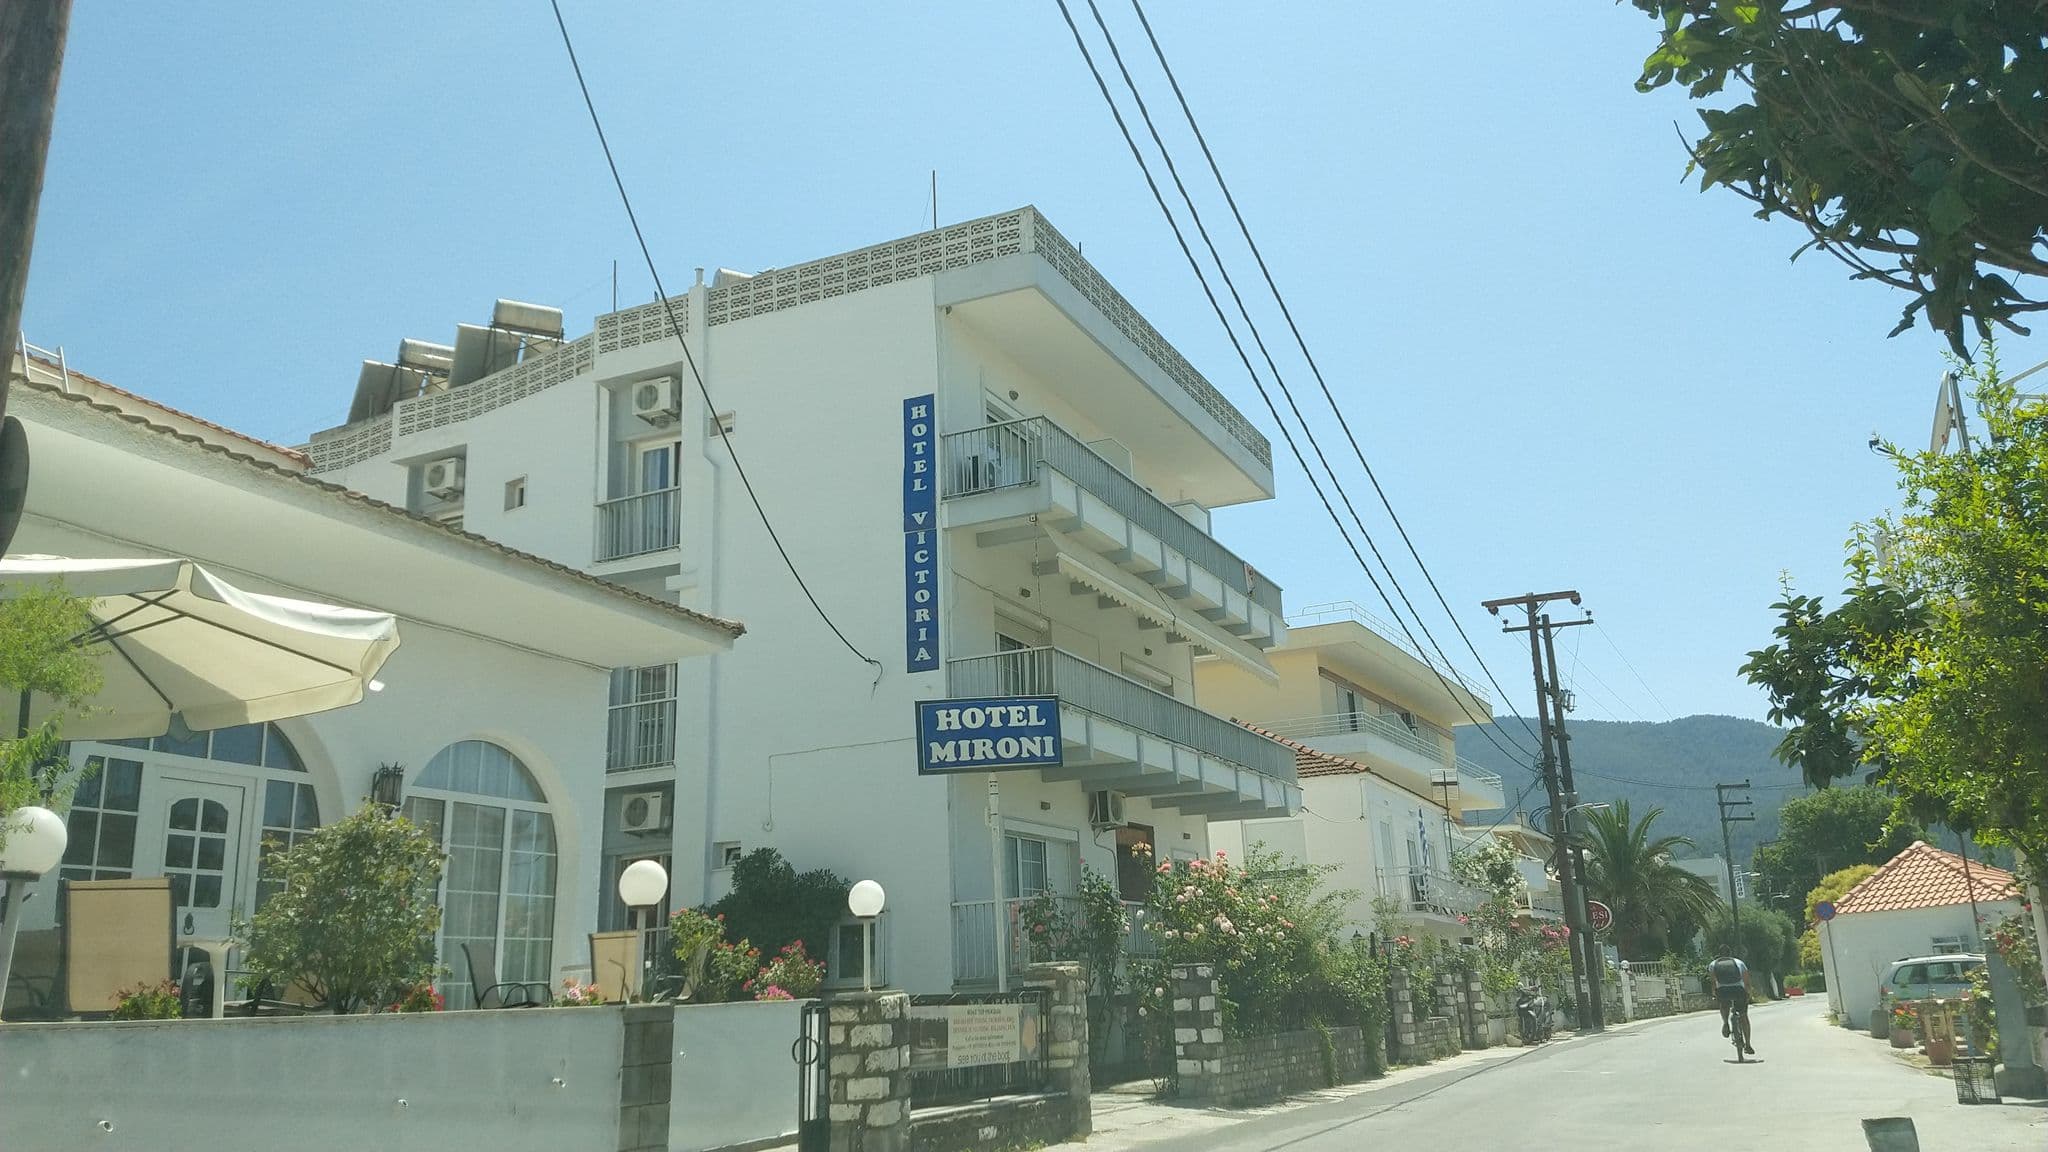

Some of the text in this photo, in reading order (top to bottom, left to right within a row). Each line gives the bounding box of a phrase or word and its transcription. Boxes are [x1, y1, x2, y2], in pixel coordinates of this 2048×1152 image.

[911, 404, 932, 662] HOTEL VICTORIA
[935, 705, 1047, 731] HOTEL
[929, 735, 1056, 764] MIRONI
[1592, 910, 1608, 920] ESI
